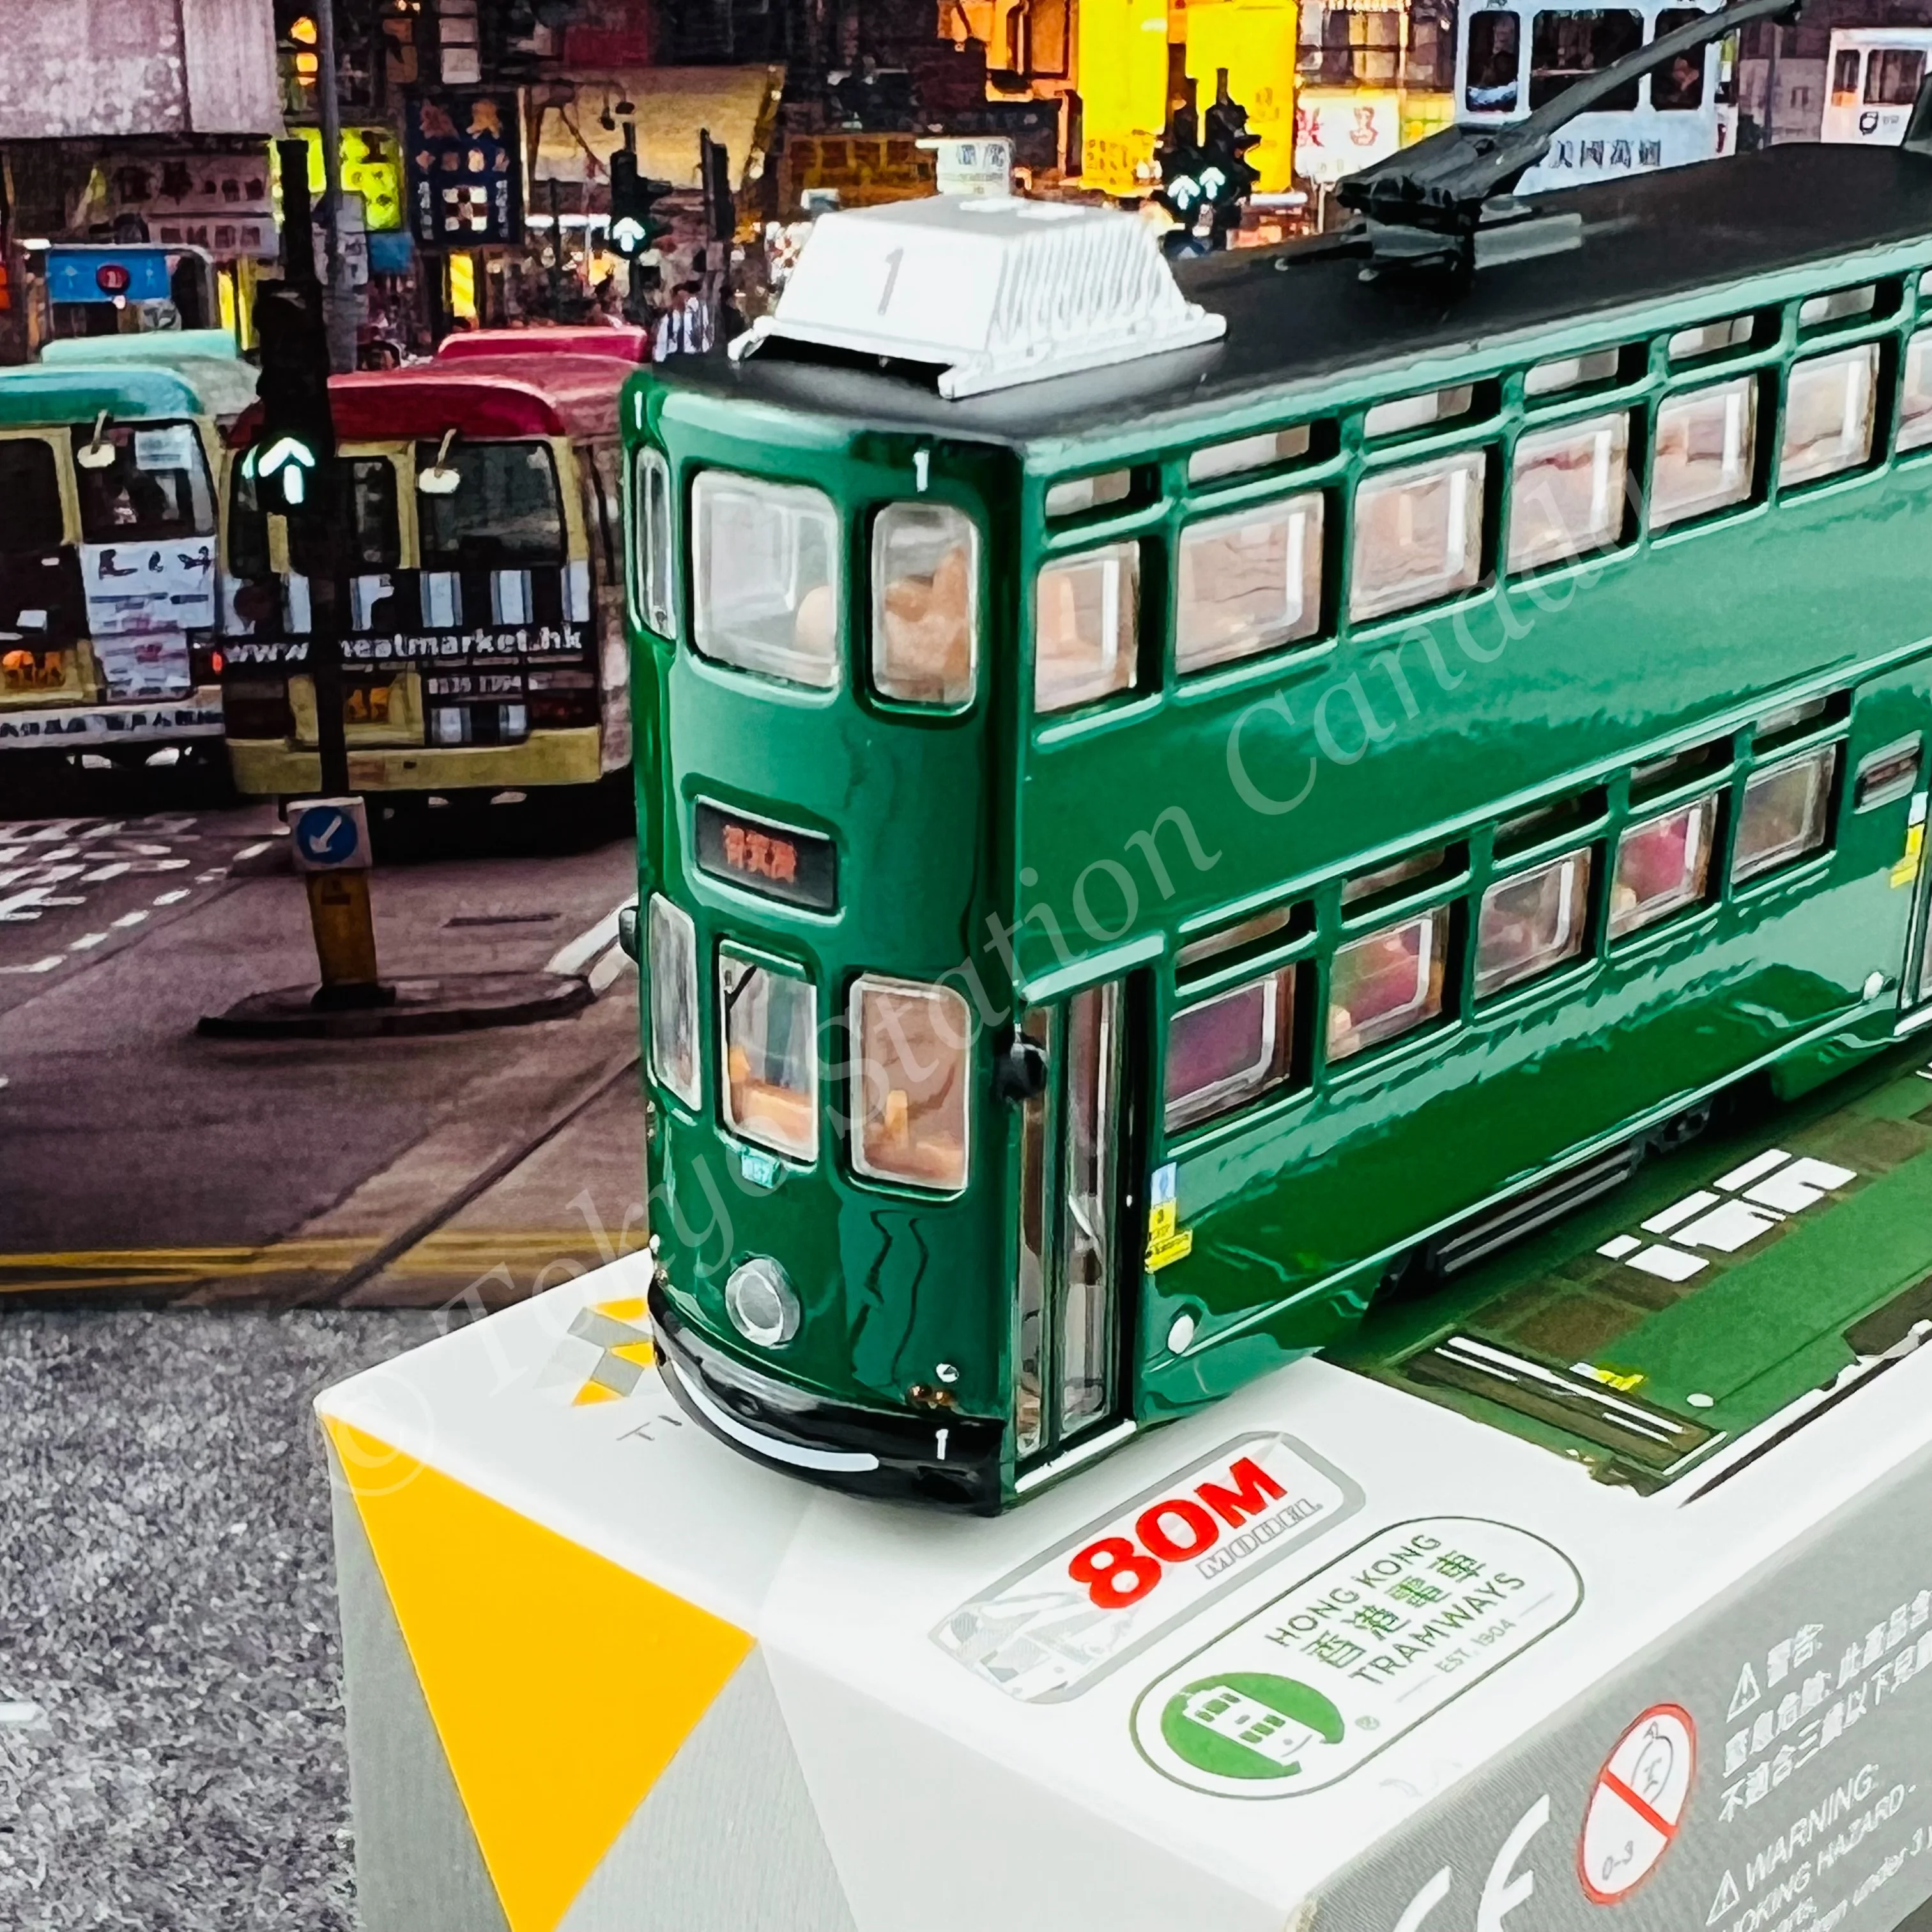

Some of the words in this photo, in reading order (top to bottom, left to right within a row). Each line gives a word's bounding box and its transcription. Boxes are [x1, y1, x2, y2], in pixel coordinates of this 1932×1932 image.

[877, 246, 905, 316] 1
[913, 449, 930, 492] 1
[935, 1429, 949, 1460] 1
[1068, 1456, 1289, 1609] 80M
[1195, 1498, 1319, 1580] MODEL
[1264, 1586, 1360, 1648] HONG
[1350, 1534, 1442, 1590] KONG
[1300, 1549, 1487, 1669] 香港電車
[1347, 1572, 1526, 1685] TRAMWAYS
[1602, 1840, 1634, 1882] 0-3
